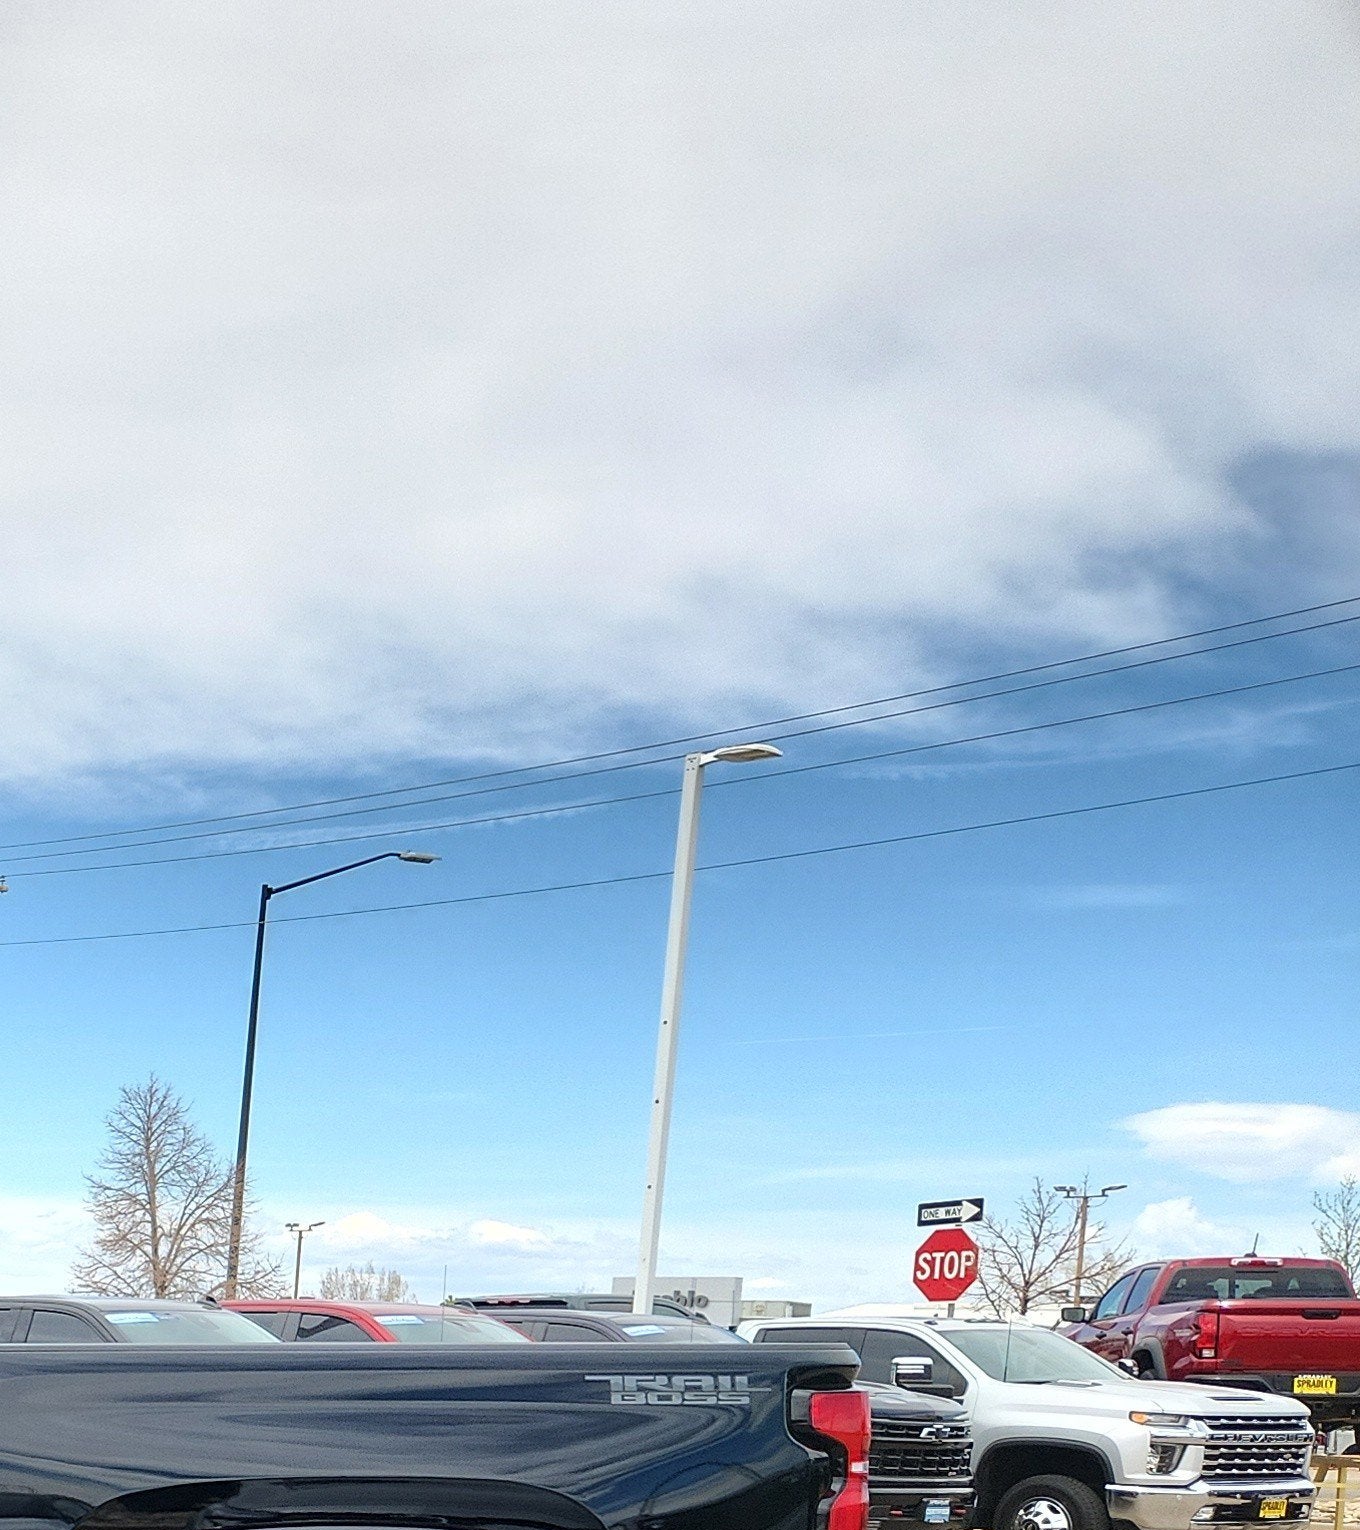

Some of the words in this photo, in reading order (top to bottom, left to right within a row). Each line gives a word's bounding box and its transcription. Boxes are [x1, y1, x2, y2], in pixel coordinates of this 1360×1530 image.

[922, 1208, 940, 1219] ONE
[944, 1206, 962, 1217] WAY
[915, 1250, 976, 1280] STOP
[584, 1375, 772, 1392] TRAIL
[1296, 1379, 1333, 1388] SPRADLEY
[611, 1391, 750, 1405] BOSS
[1208, 1432, 1314, 1443] CHEVROLET
